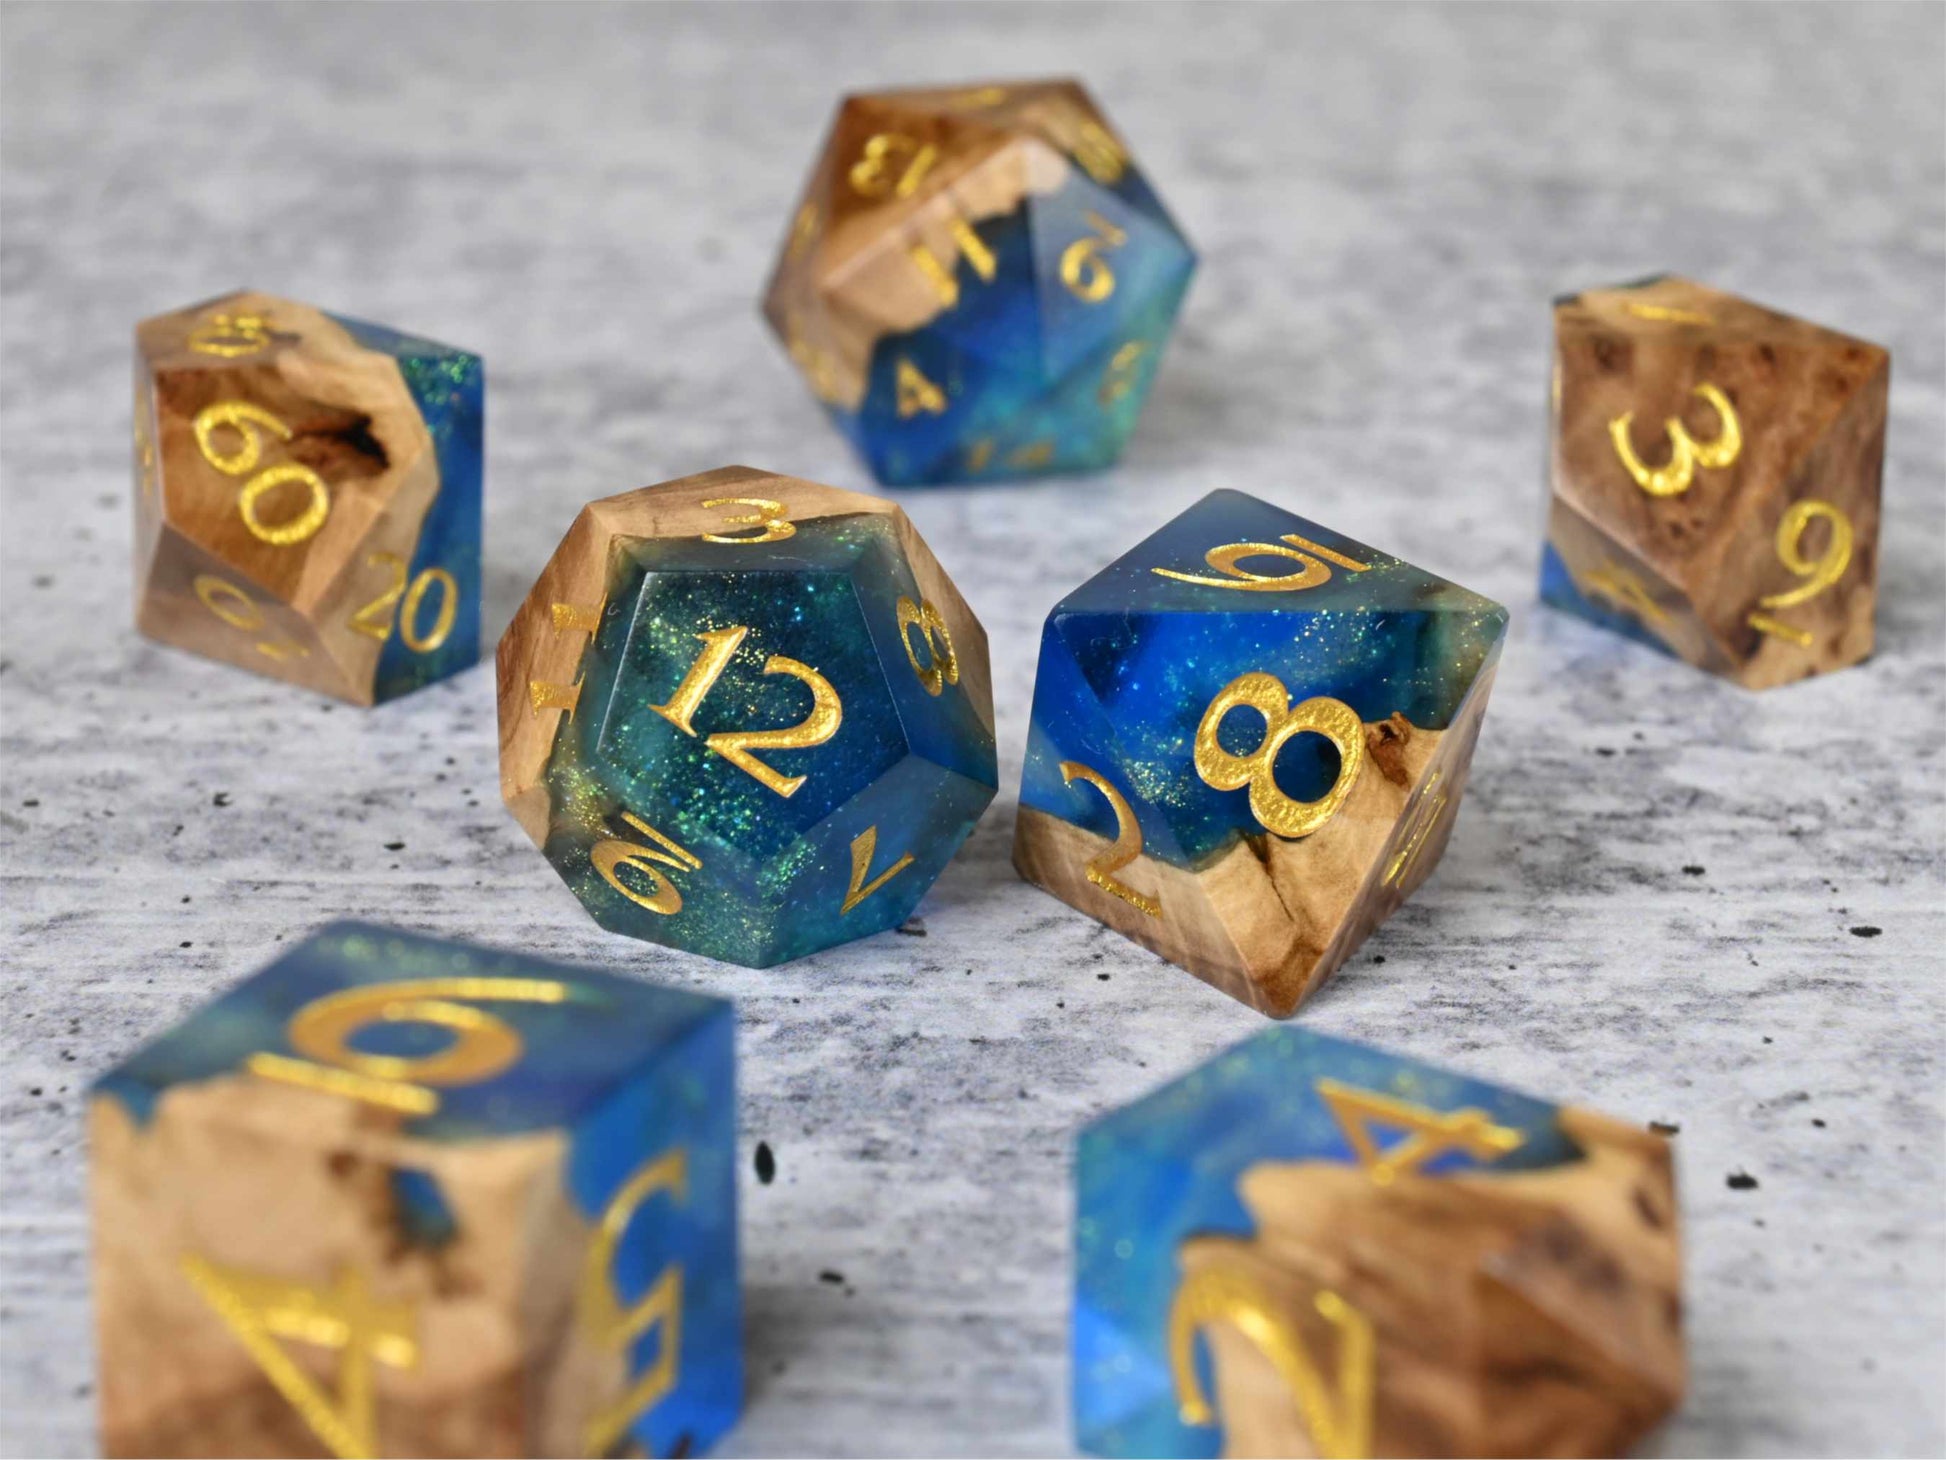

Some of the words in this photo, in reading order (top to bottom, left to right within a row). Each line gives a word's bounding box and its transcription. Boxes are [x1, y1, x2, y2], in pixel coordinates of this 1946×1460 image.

[909, 213, 998, 309] 11
[193, 402, 330, 545] 60
[1608, 381, 1743, 497] 3
[702, 498, 797, 544] 3
[348, 551, 460, 653] 20
[896, 595, 960, 698] 8
[648, 625, 843, 799] 12
[1193, 671, 1367, 839] 8
[839, 824, 916, 916] 7
[1059, 760, 1163, 919] 2
[1315, 1077, 1529, 1188] 4
